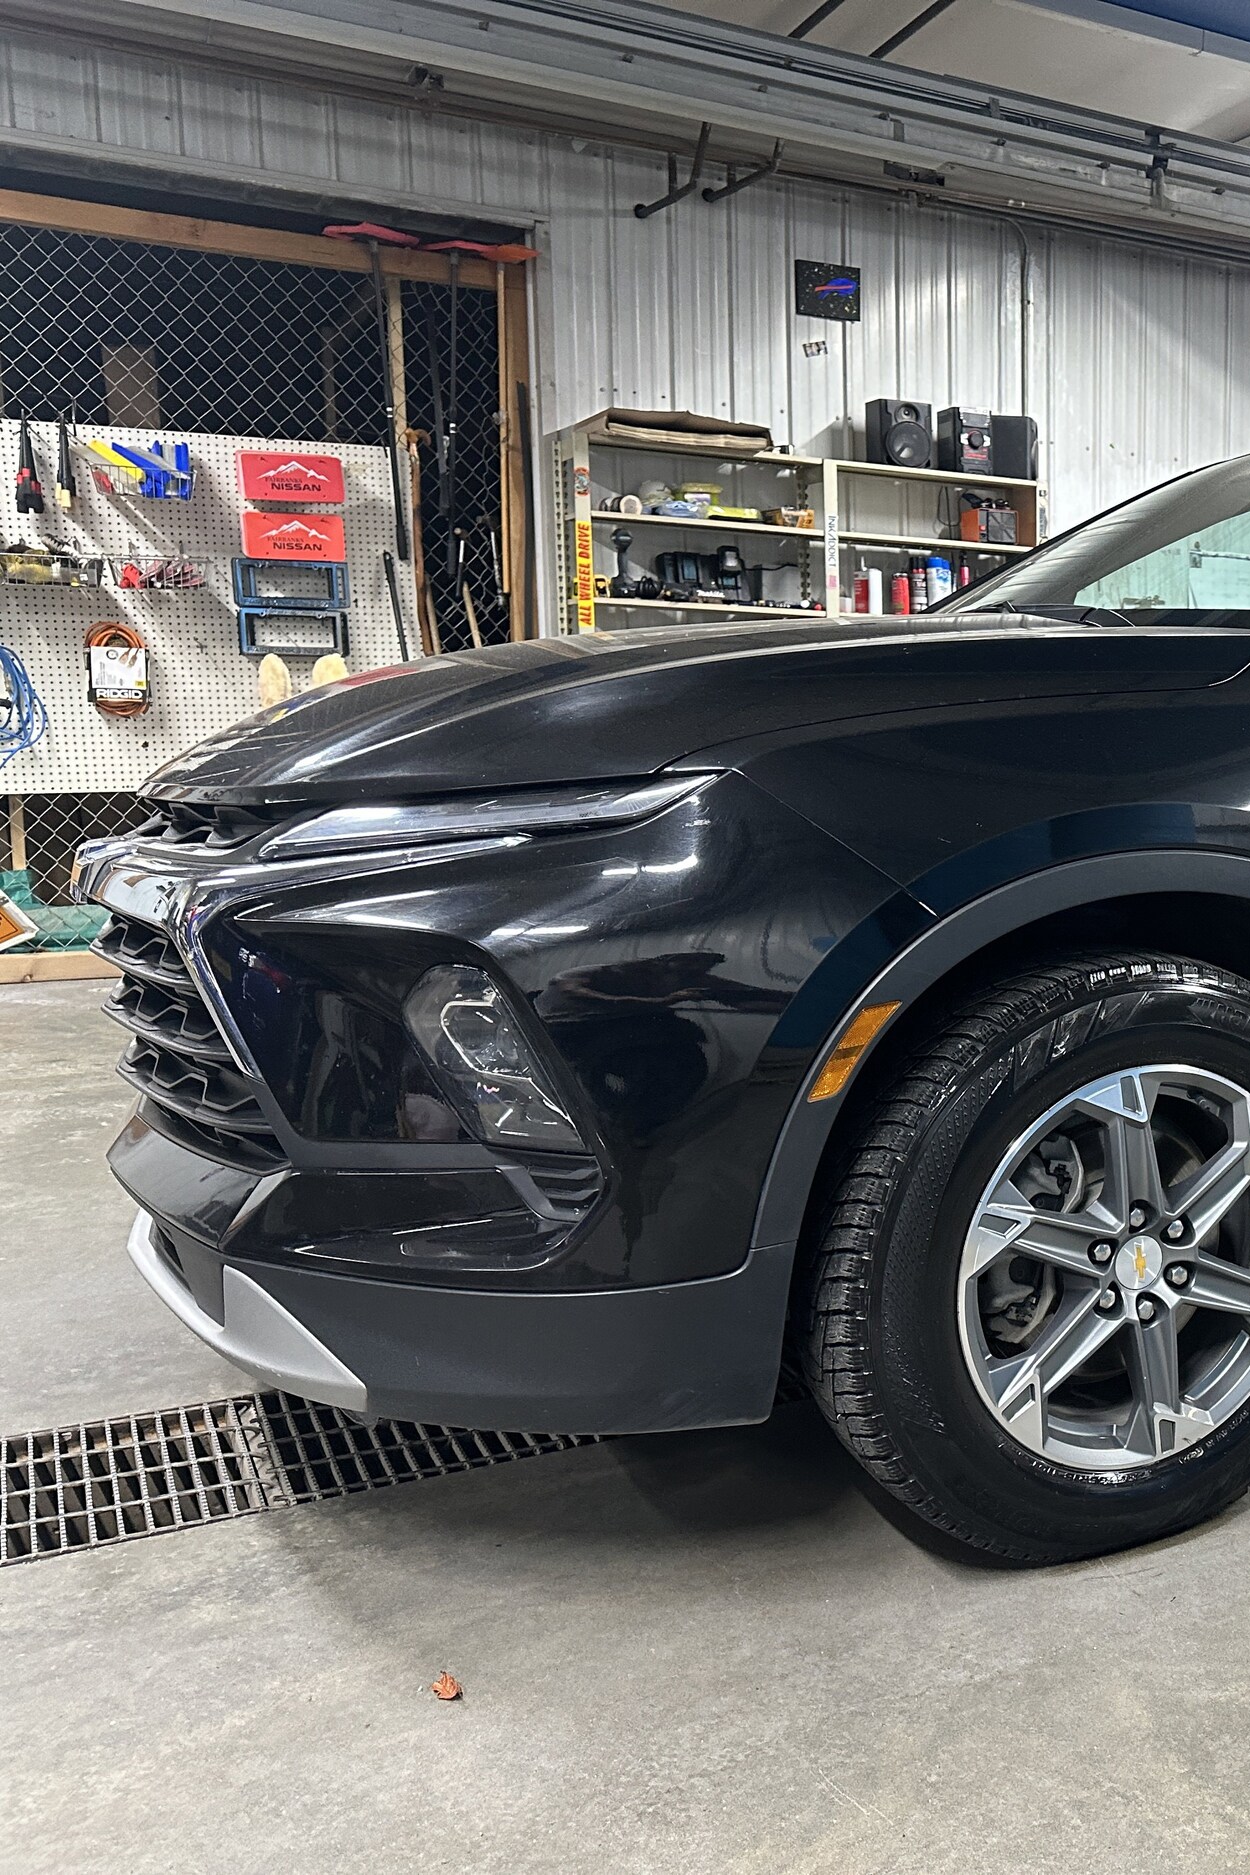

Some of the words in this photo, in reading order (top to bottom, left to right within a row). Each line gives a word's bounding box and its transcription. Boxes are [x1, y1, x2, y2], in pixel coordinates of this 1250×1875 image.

[271, 482, 321, 491] NISSAN
[273, 542, 322, 551] NISSAN
[577, 522, 590, 559] DRIVE
[577, 563, 591, 601] WHEEL
[578, 604, 592, 626] ALL
[96, 689, 143, 699] RIDGID
